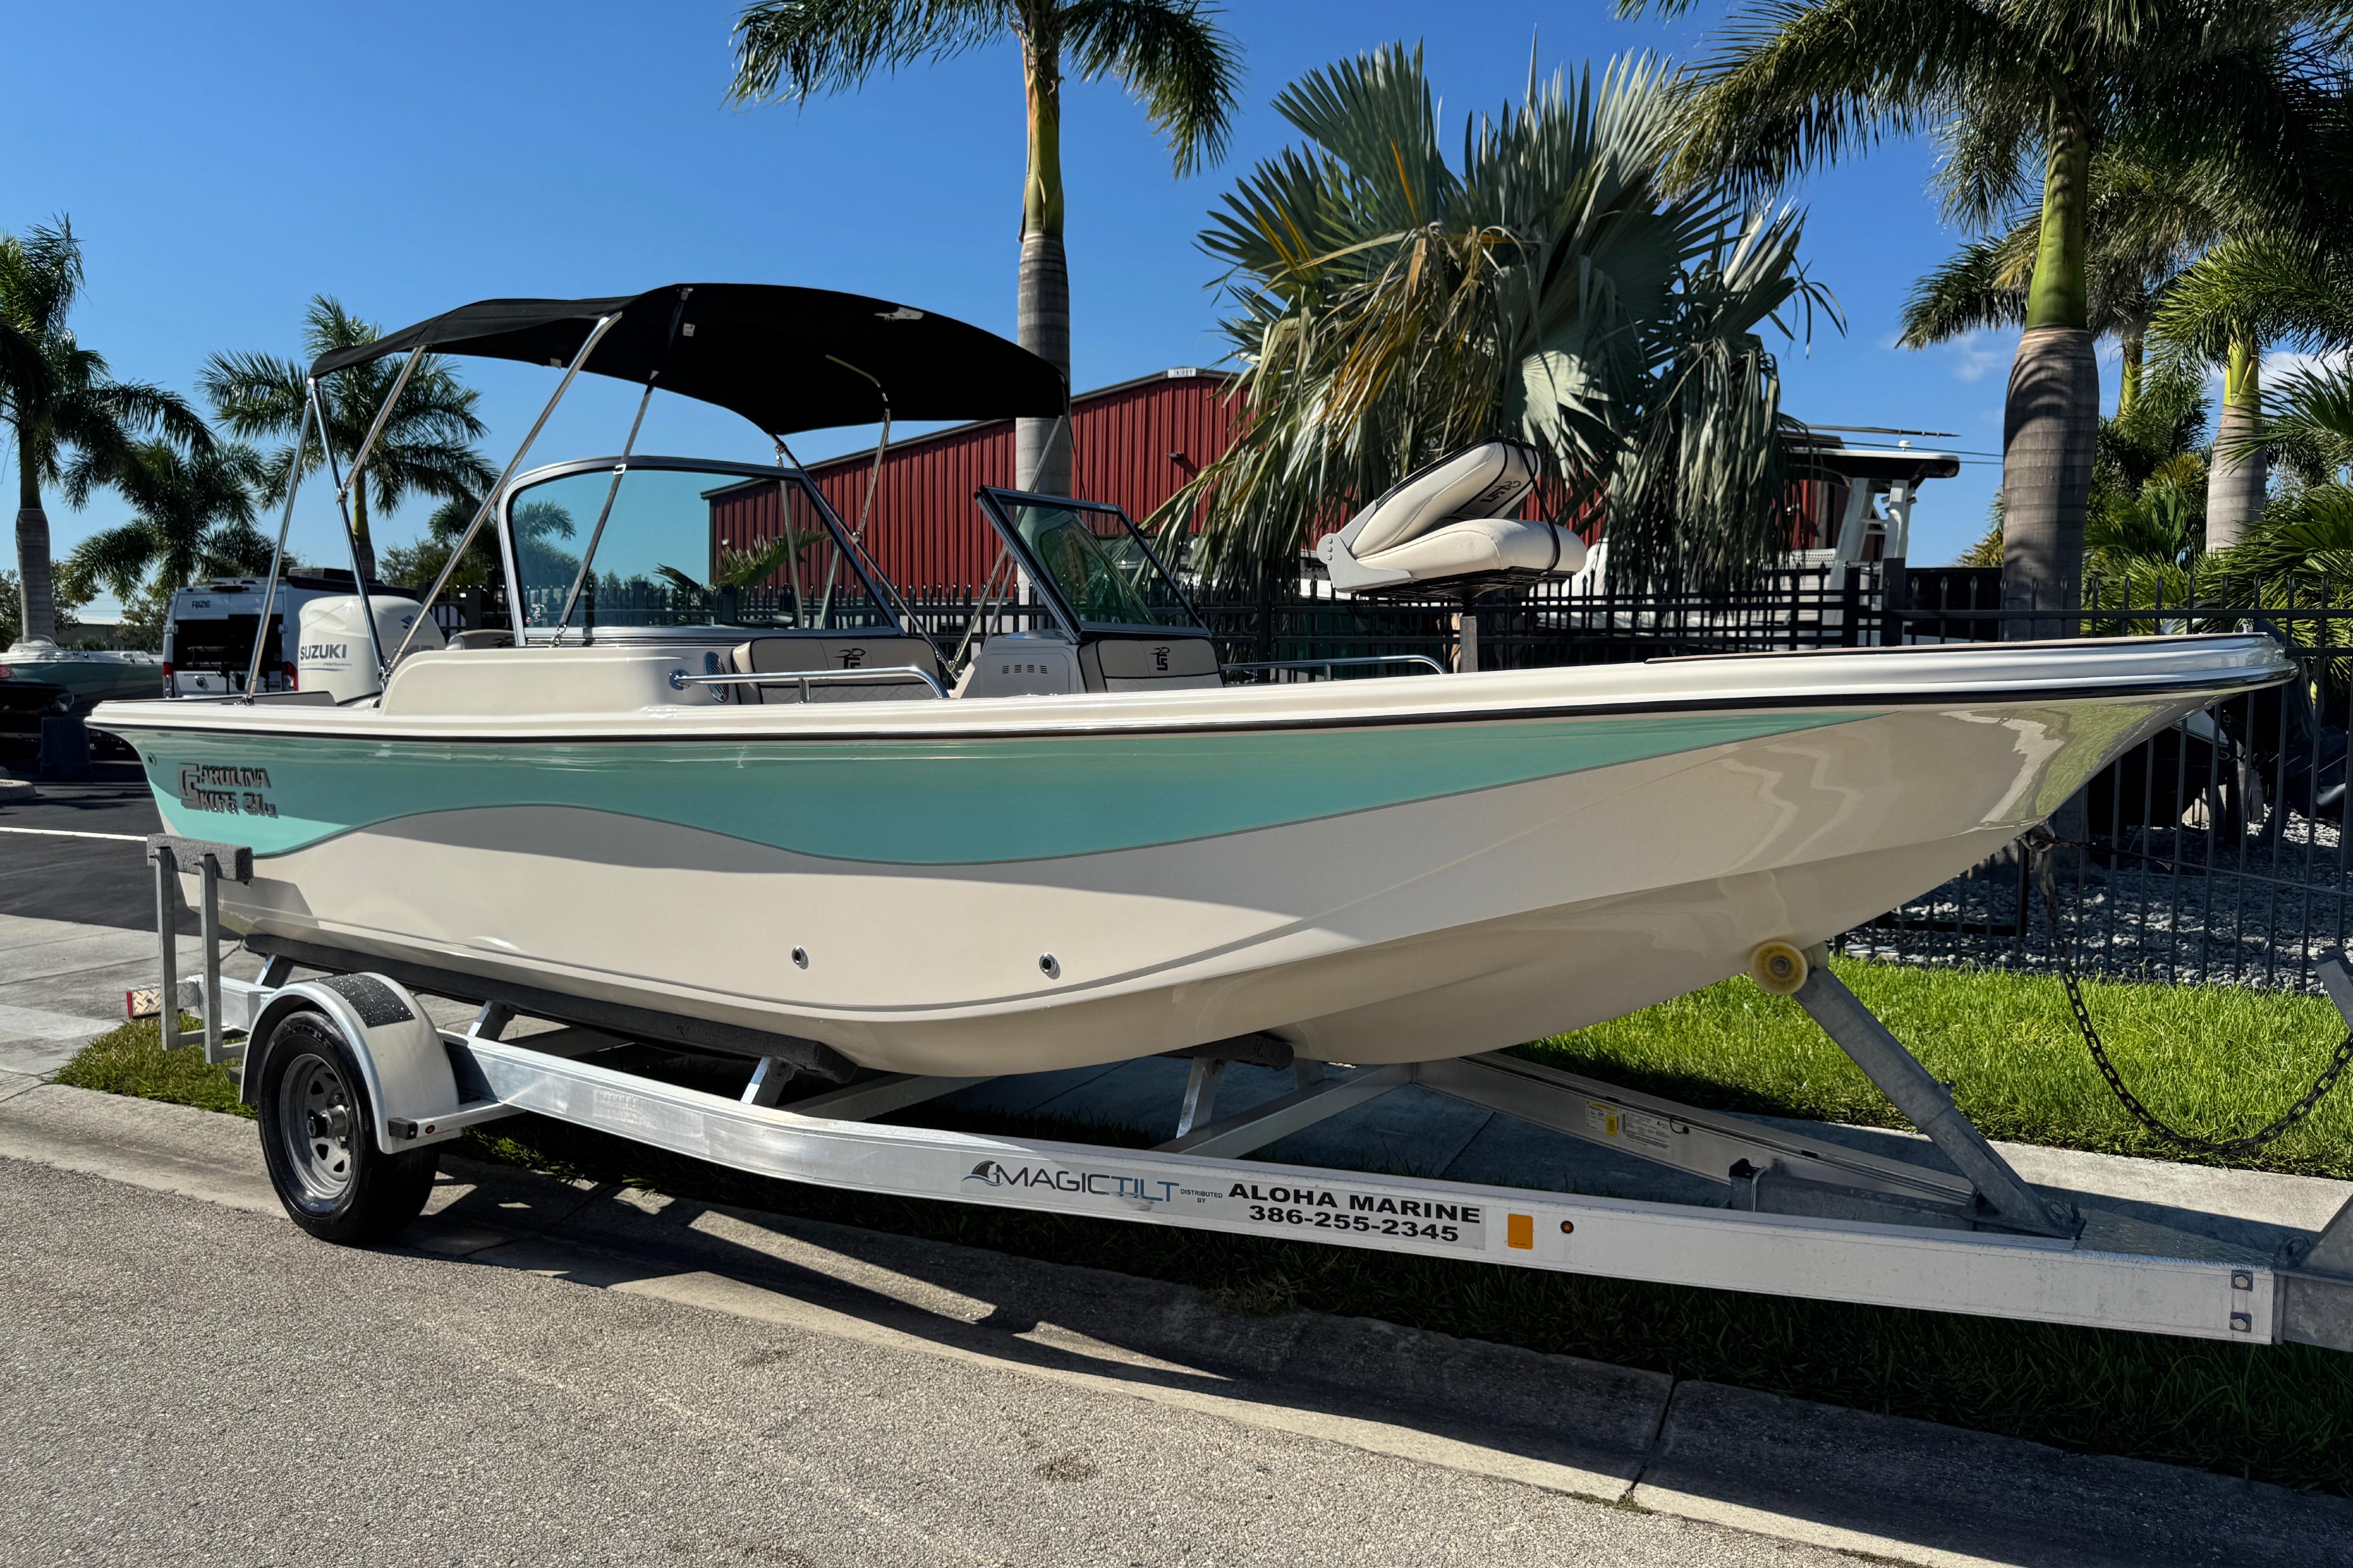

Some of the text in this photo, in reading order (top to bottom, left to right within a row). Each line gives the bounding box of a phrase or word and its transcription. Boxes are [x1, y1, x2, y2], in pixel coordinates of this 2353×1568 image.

[192, 600, 211, 609] RIZE
[300, 644, 347, 660] SUZUKI
[178, 762, 272, 795] CAROLINA
[181, 775, 240, 816] SKIFF
[996, 1165, 1179, 1202] MAGICTILT
[1180, 1188, 1223, 1198] DISTRIBUTED
[1228, 1183, 1480, 1224] ALOHA MARINE
[1249, 1205, 1459, 1242] 386-255-2345
